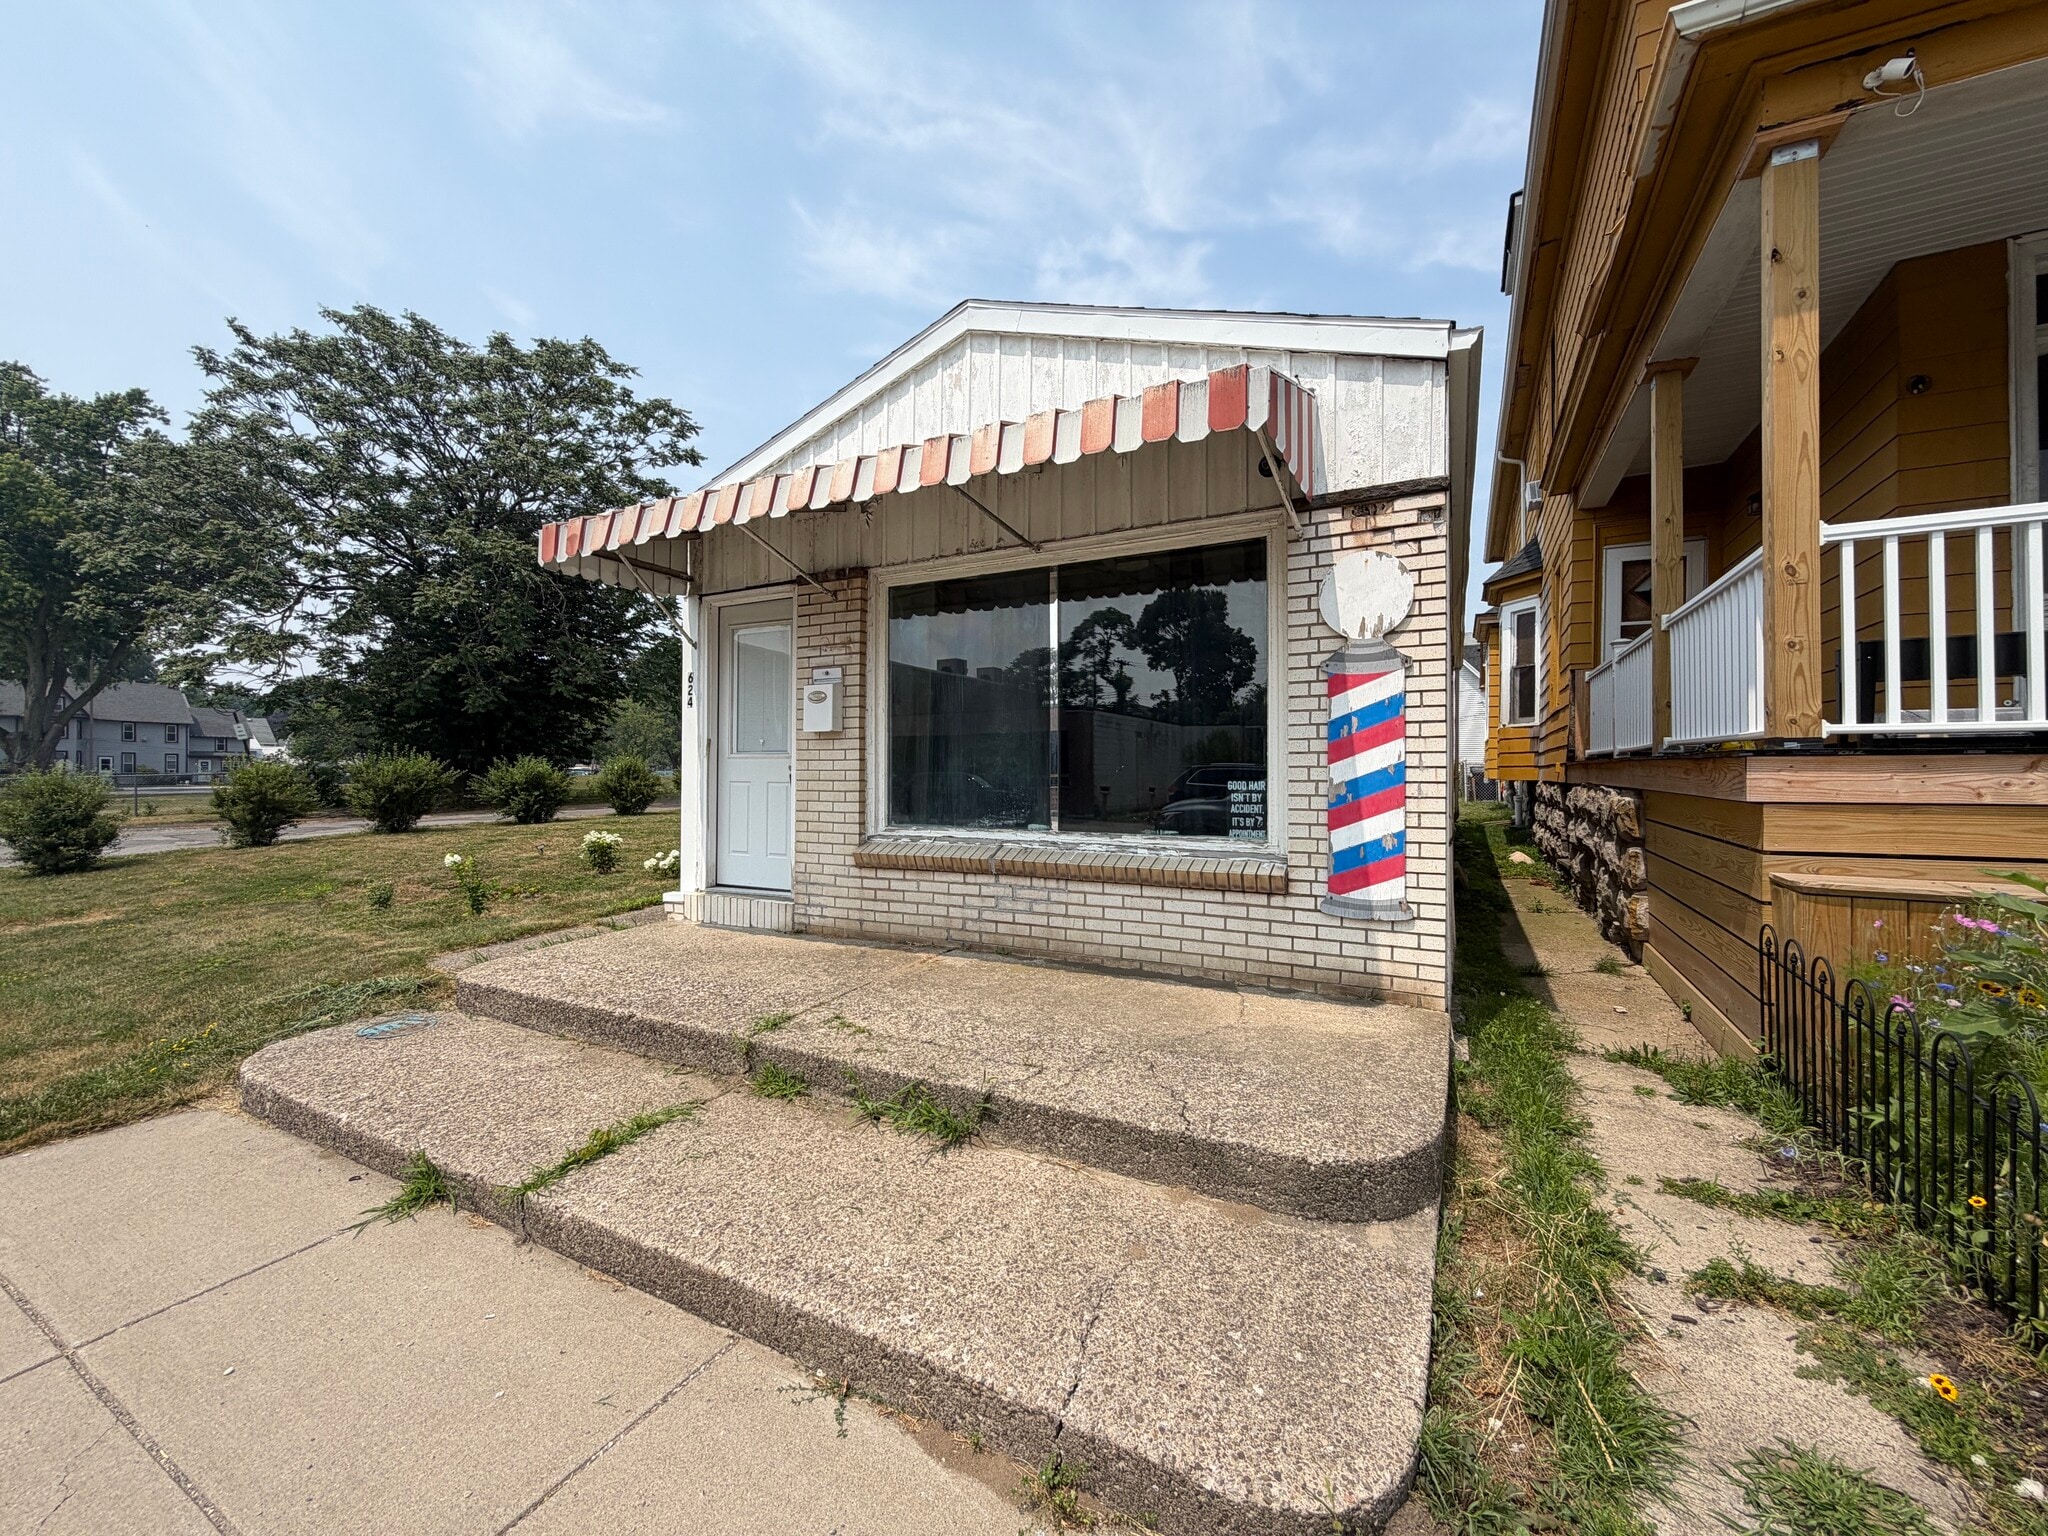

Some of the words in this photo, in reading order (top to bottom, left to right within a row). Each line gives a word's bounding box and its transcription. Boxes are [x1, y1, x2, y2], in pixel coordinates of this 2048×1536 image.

[1227, 780, 1247, 791] GOOD
[1248, 780, 1266, 791] HAIR
[1231, 793, 1251, 802] ISN'T
[1252, 793, 1262, 802] BY
[1230, 804, 1265, 814] ACCIDENT.
[1232, 817, 1245, 826] IT'S
[1245, 817, 1255, 826] BY
